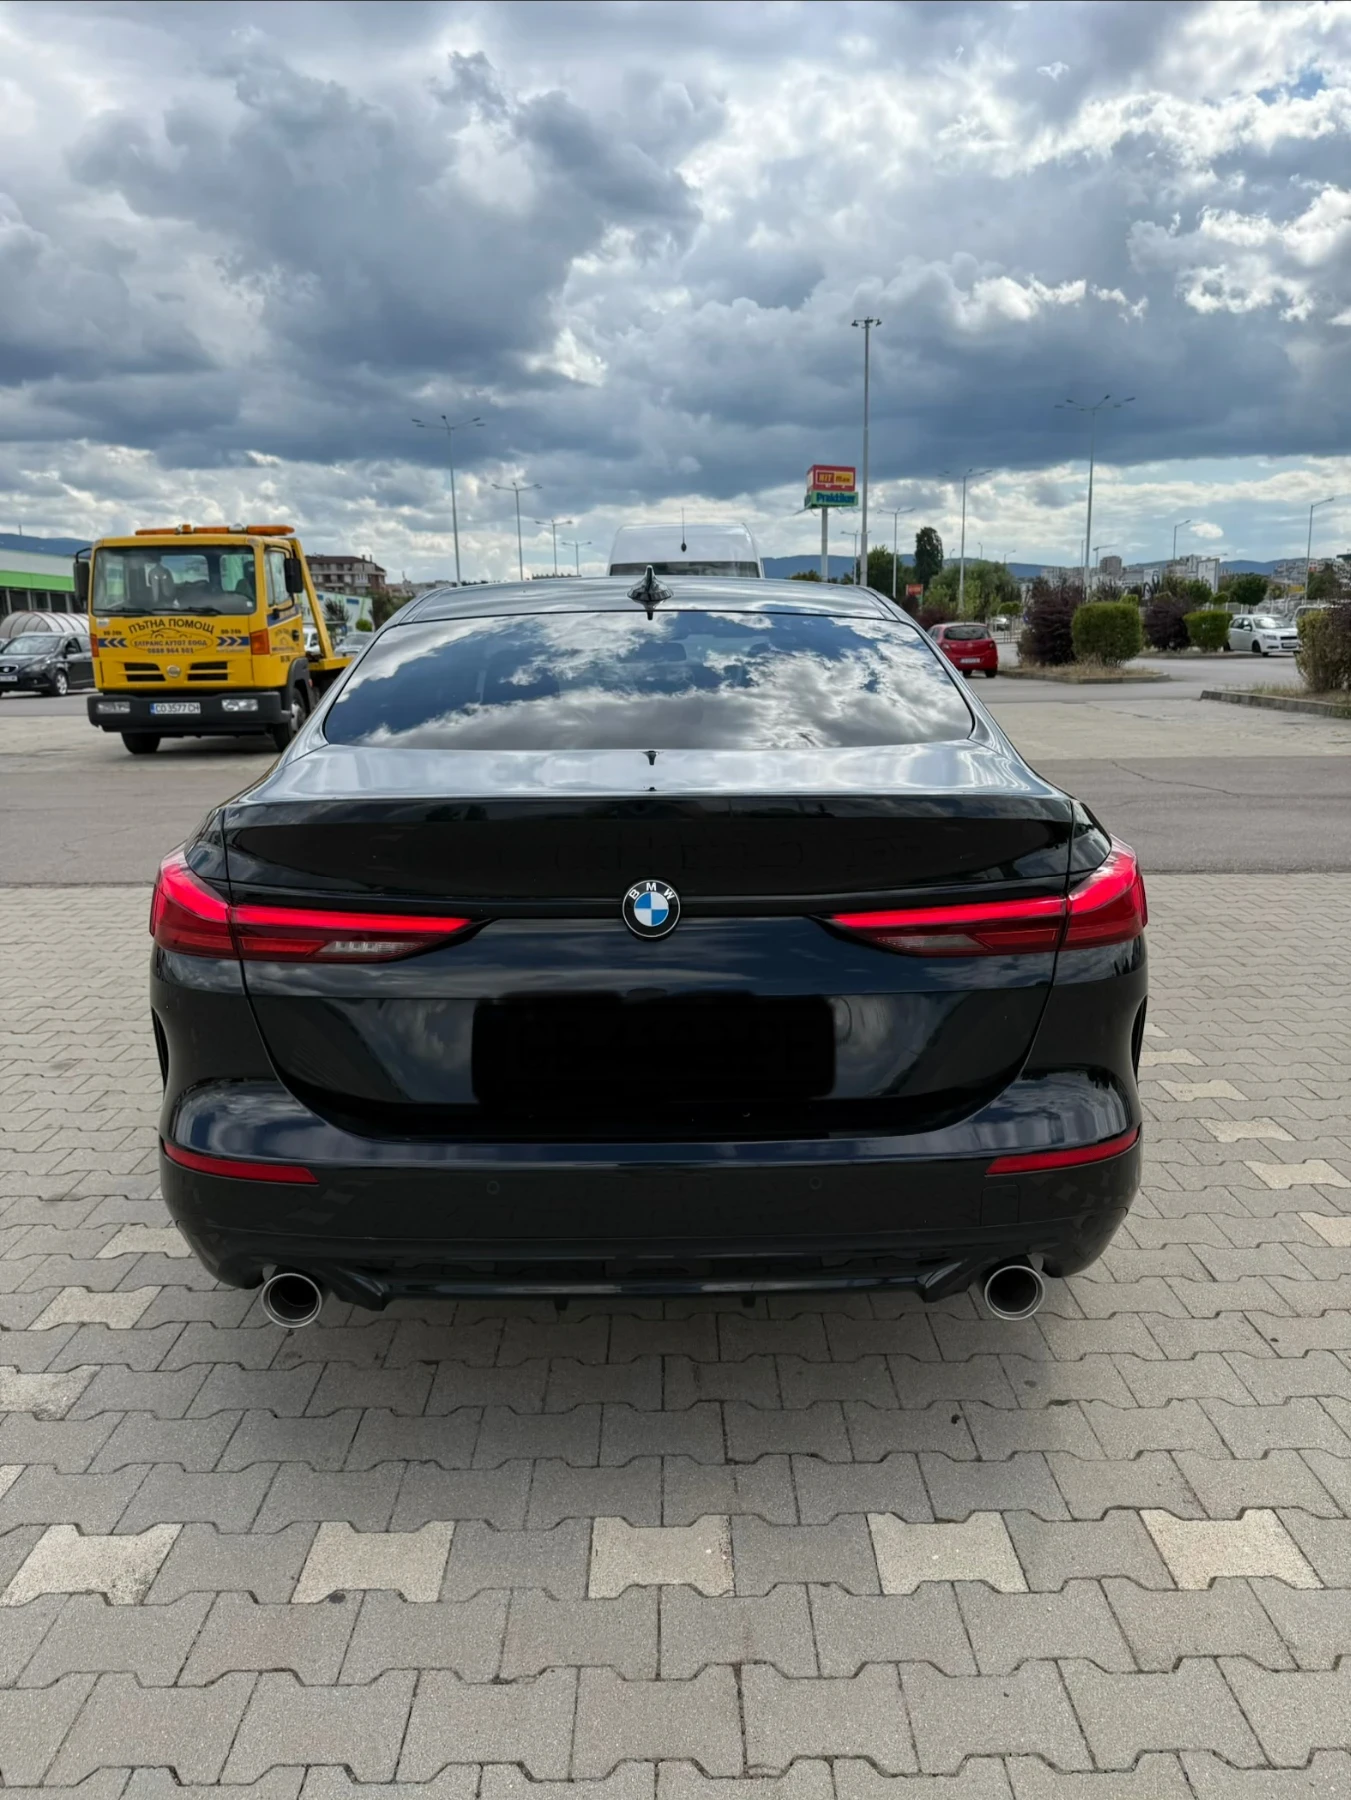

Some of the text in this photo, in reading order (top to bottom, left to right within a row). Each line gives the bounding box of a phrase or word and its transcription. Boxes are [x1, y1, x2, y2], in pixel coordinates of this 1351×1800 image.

[128, 618, 215, 635] ПЪТНА ПОМОЩ
[629, 882, 675, 900] BMW
